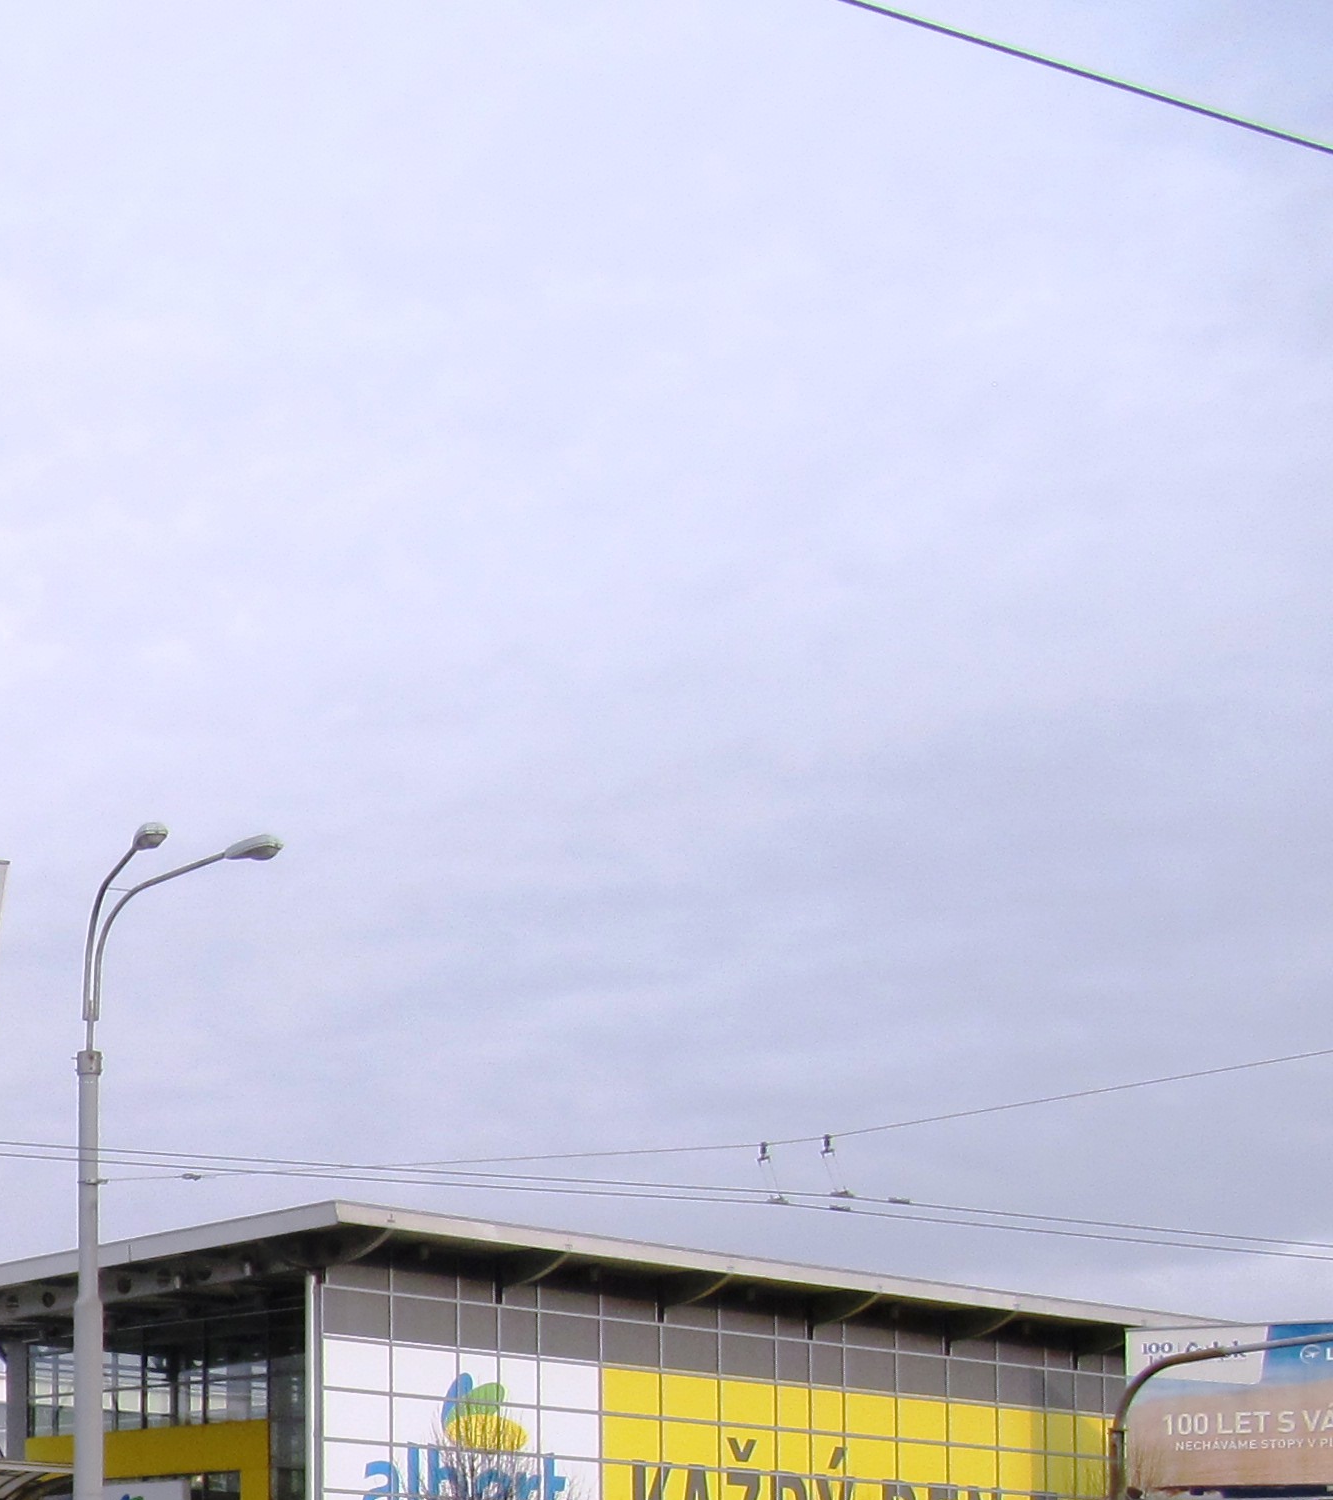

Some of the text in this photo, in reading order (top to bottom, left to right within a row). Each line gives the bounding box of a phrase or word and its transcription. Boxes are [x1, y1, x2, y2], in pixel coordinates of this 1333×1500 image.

[1163, 1413, 1209, 1435] 100
[1217, 1411, 1270, 1434] LET
[1277, 1410, 1295, 1433] S
